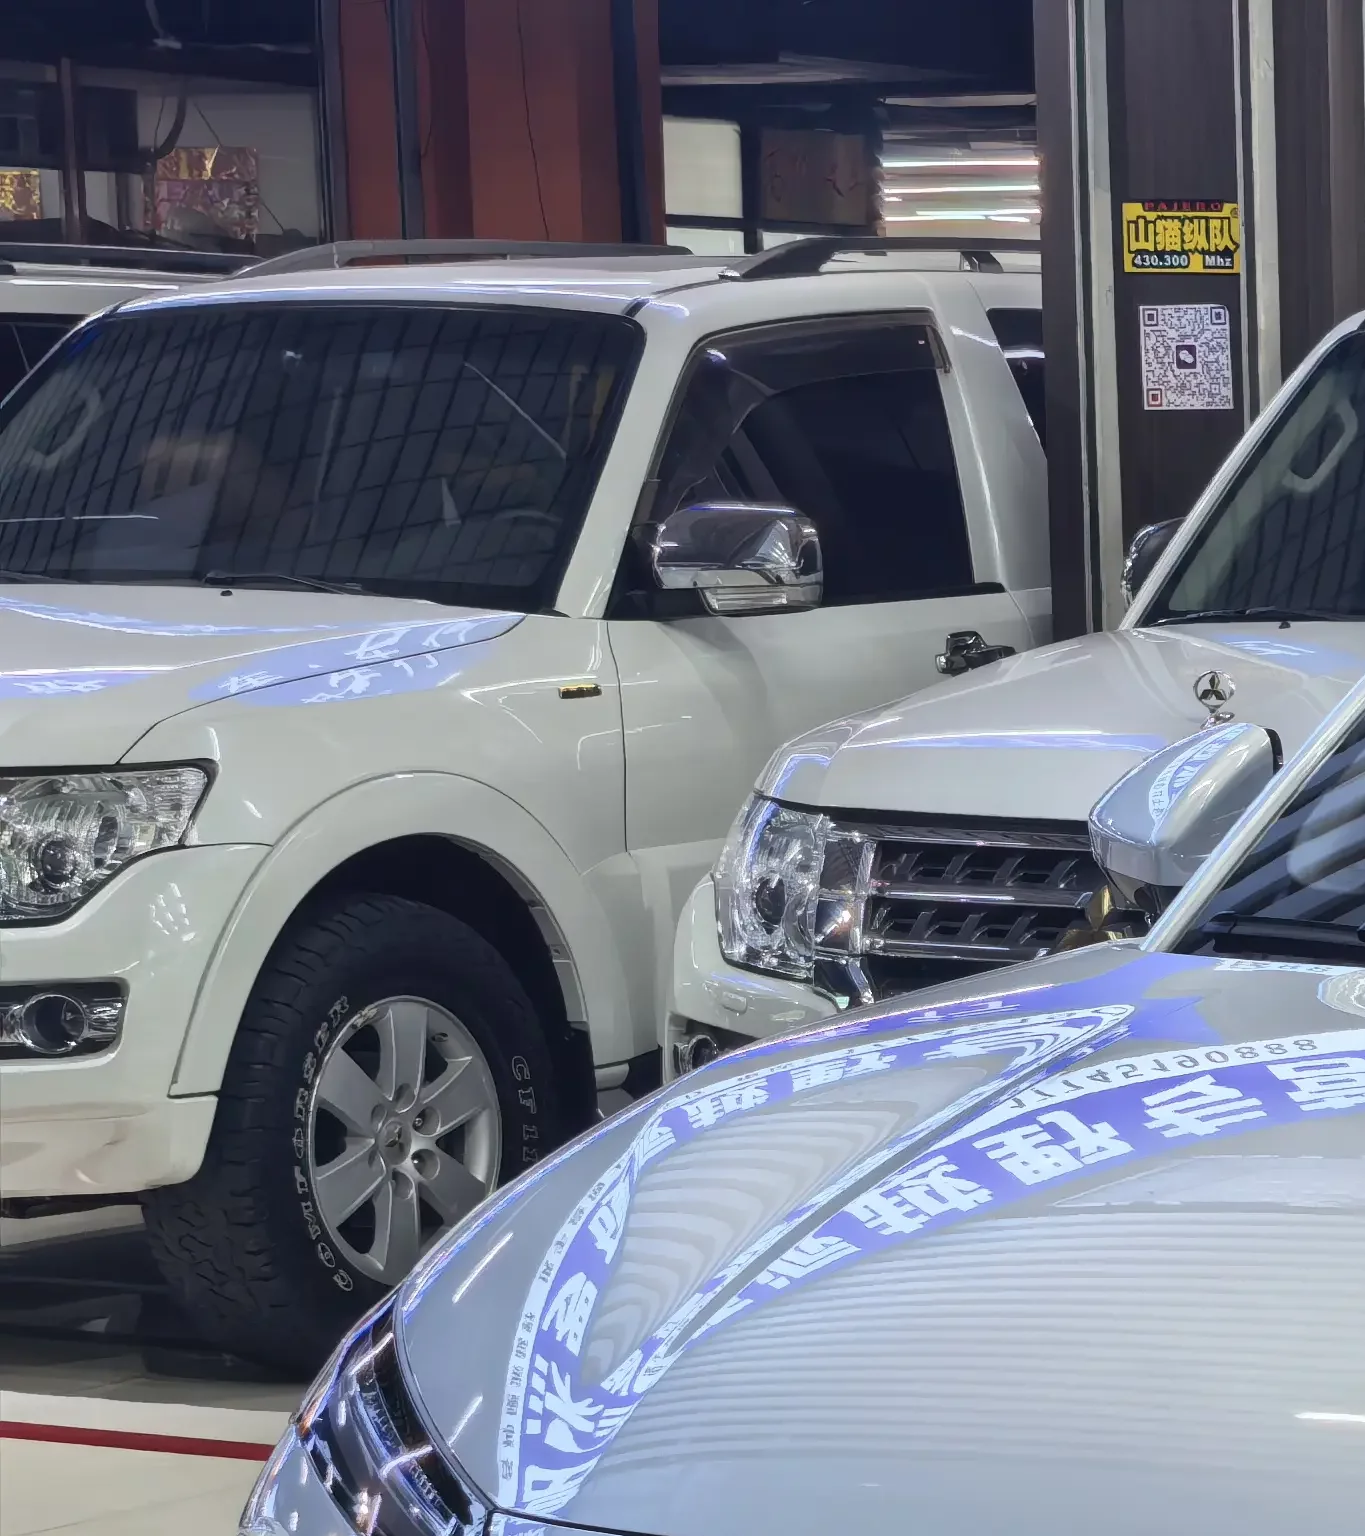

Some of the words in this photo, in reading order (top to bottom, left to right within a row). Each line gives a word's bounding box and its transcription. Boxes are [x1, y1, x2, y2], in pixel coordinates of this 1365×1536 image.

[1129, 217, 1237, 252] 山猫纵队
[1133, 254, 1189, 267] 430.300
[1204, 254, 1233, 267] Mhz
